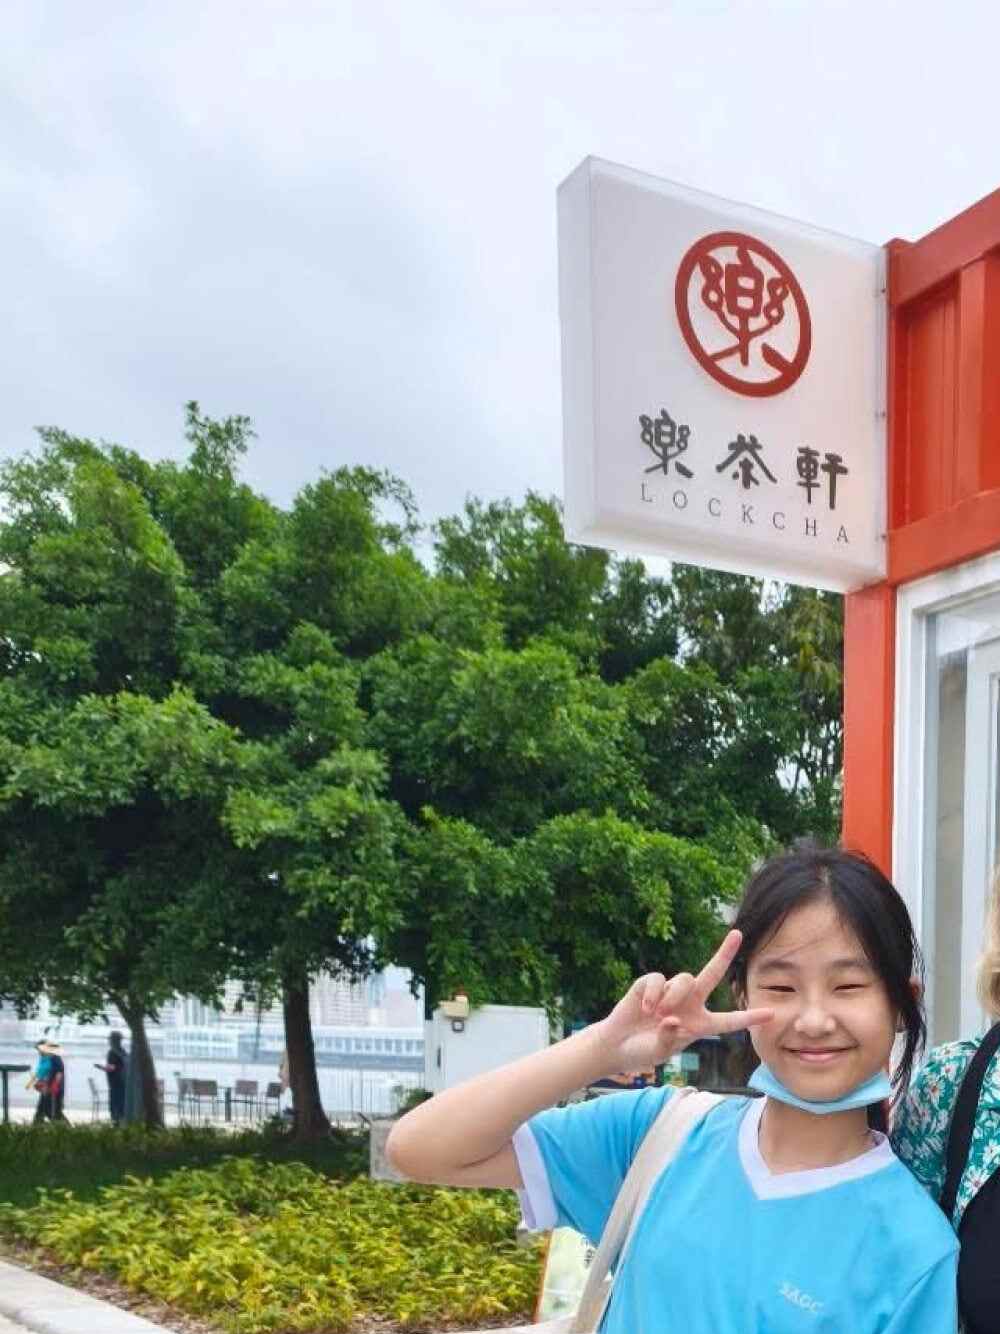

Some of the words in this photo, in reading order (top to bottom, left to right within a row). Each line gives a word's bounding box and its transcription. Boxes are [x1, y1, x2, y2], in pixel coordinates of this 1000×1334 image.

[639, 408, 849, 511] 樂茶軒
[640, 482, 850, 544] LOCKCHA
